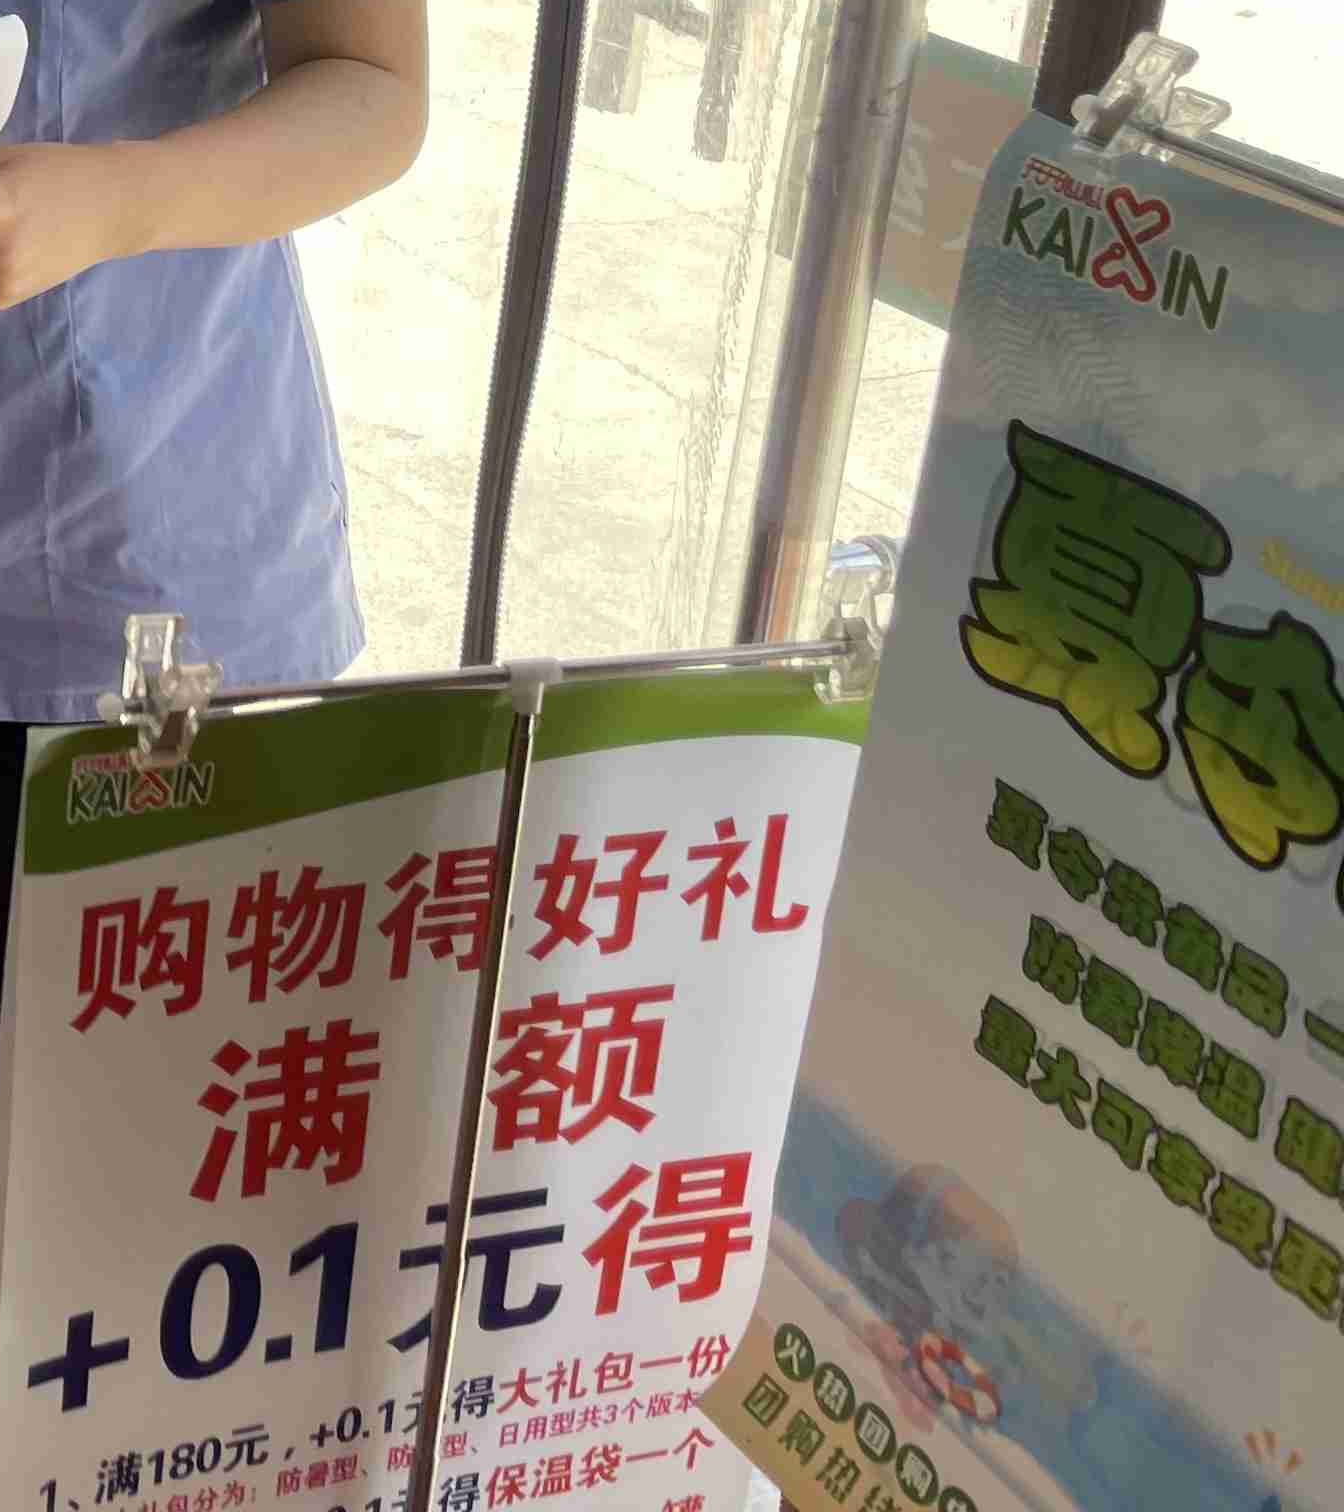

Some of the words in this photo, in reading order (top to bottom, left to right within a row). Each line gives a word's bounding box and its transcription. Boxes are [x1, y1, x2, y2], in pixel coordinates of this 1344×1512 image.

[69, 811, 810, 1034] 购物得好礼
